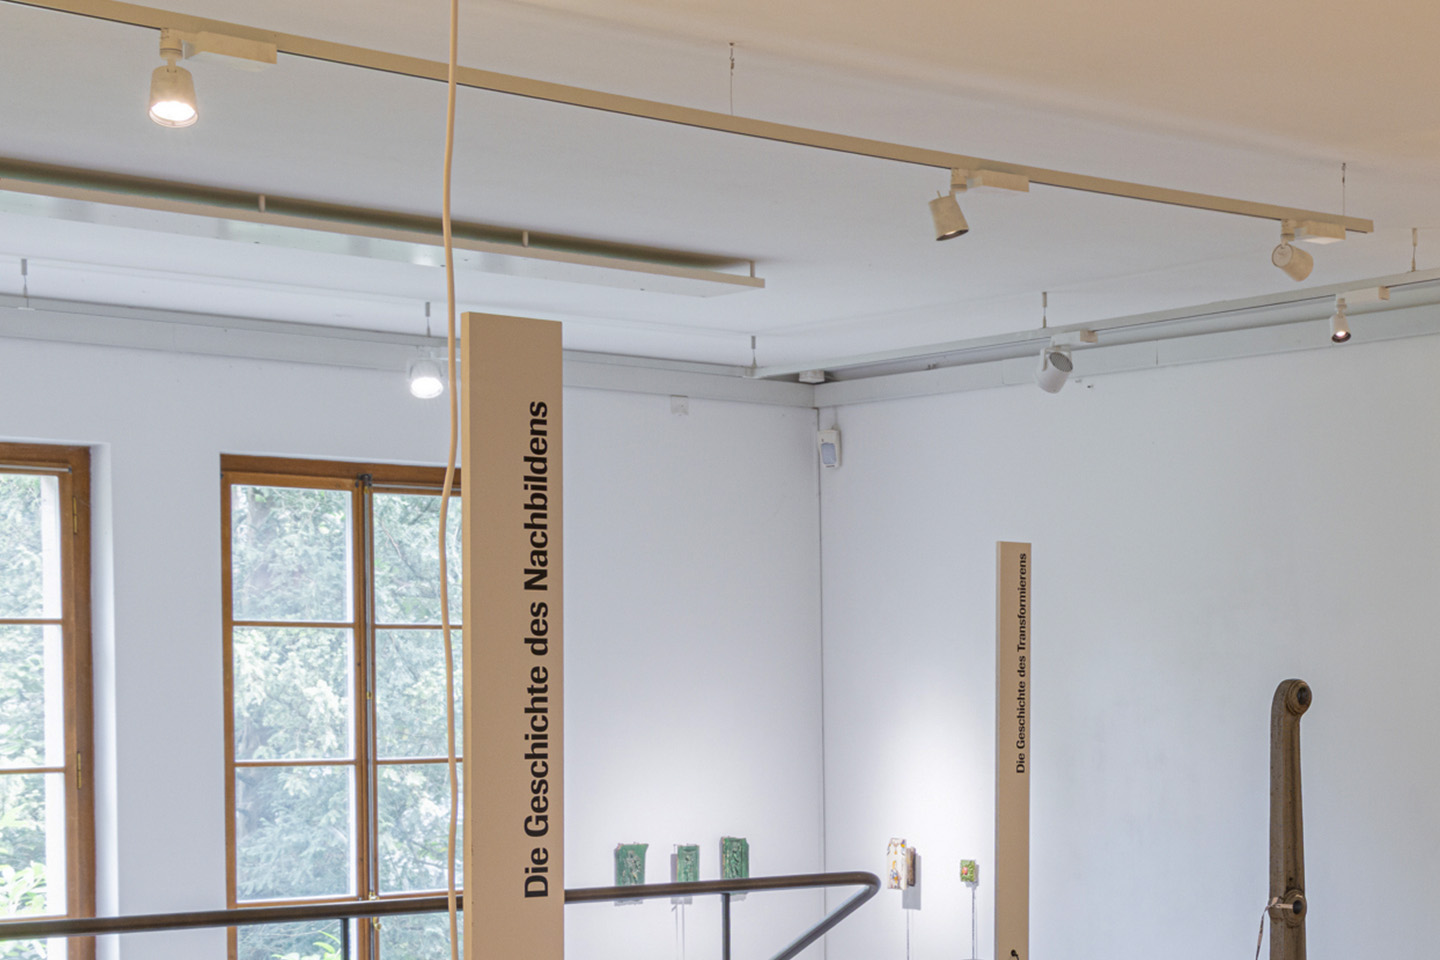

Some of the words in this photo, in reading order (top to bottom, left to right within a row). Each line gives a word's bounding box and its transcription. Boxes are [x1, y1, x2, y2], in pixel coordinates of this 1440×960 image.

[523, 401, 548, 591] Nachbildens
[523, 602, 549, 656] des
[1016, 553, 1027, 653] Transformierens
[1016, 655, 1026, 678] des
[1016, 680, 1026, 750] Geschichte
[524, 667, 549, 838] Geschichte
[1016, 752, 1026, 774] Die
[524, 848, 549, 898] Die
